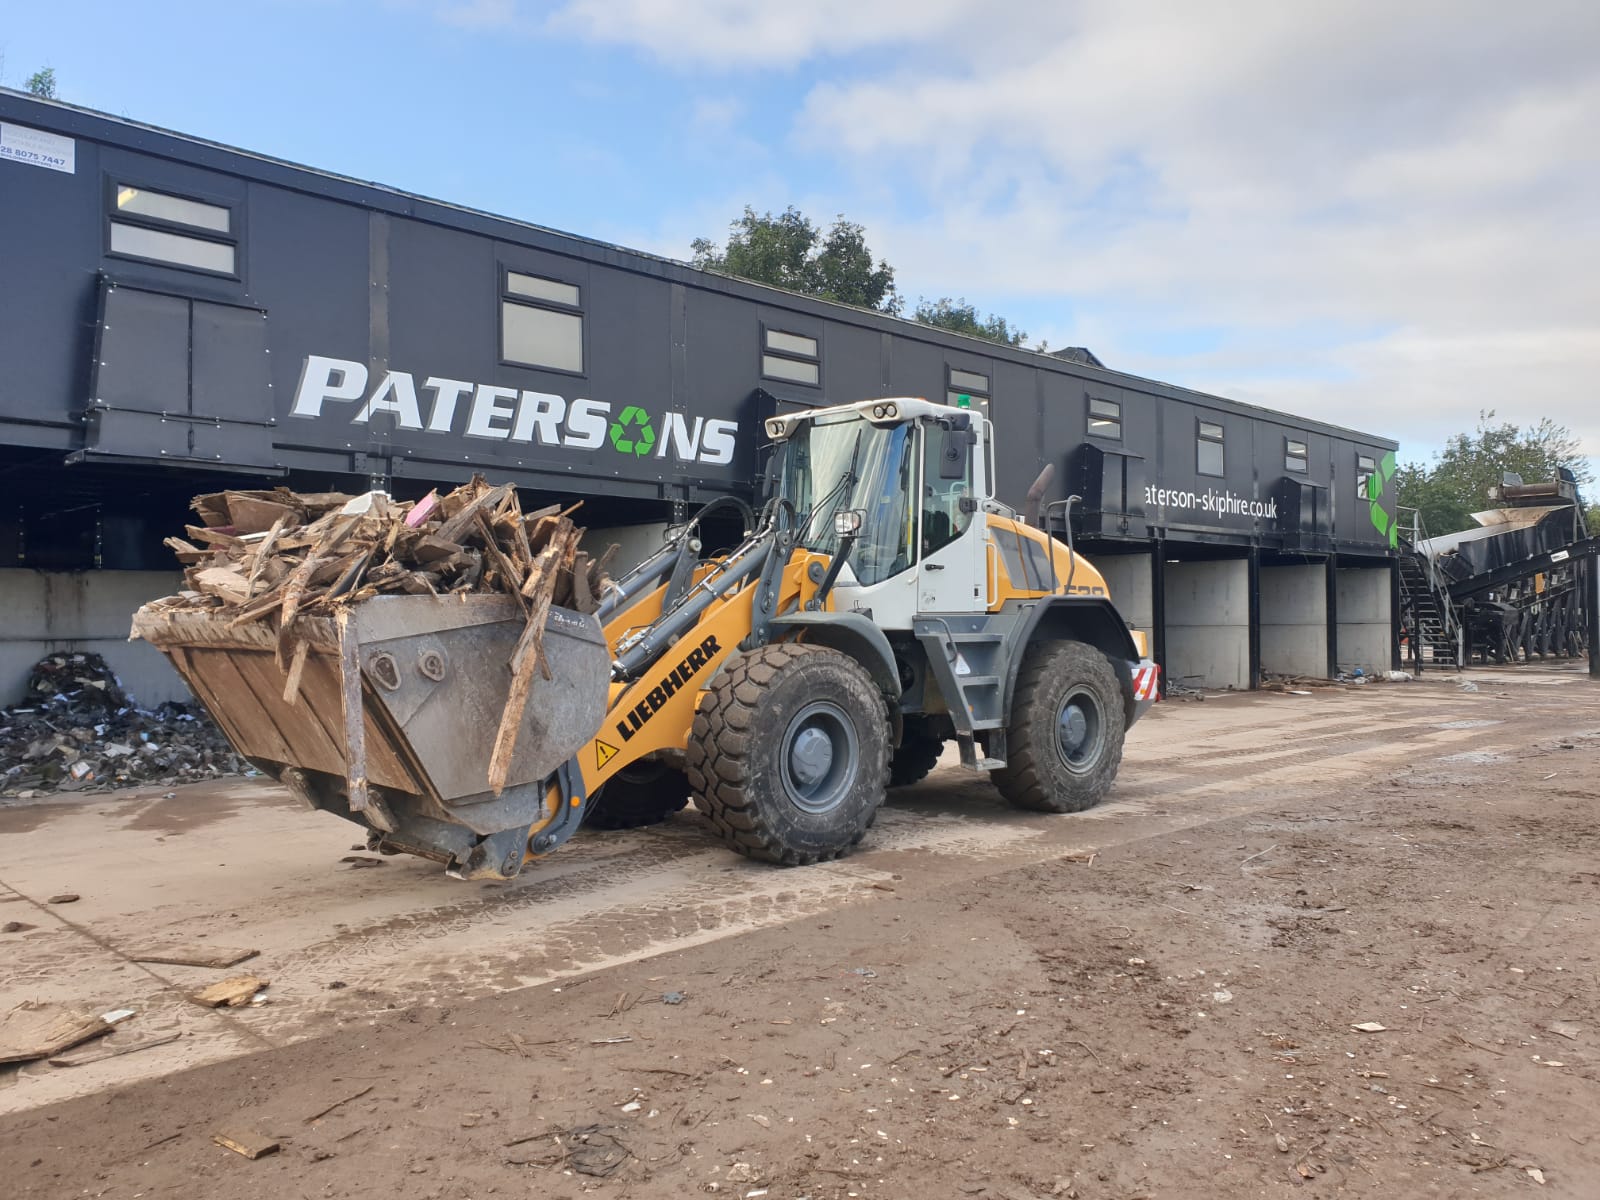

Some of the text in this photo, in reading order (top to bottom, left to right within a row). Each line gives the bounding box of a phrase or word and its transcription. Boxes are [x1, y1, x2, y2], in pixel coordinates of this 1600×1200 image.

[41, 154, 66, 166] 7447
[1144, 484, 1277, 519] aterson-skiphire.co.uk
[615, 634, 722, 742] LIEBHERR
